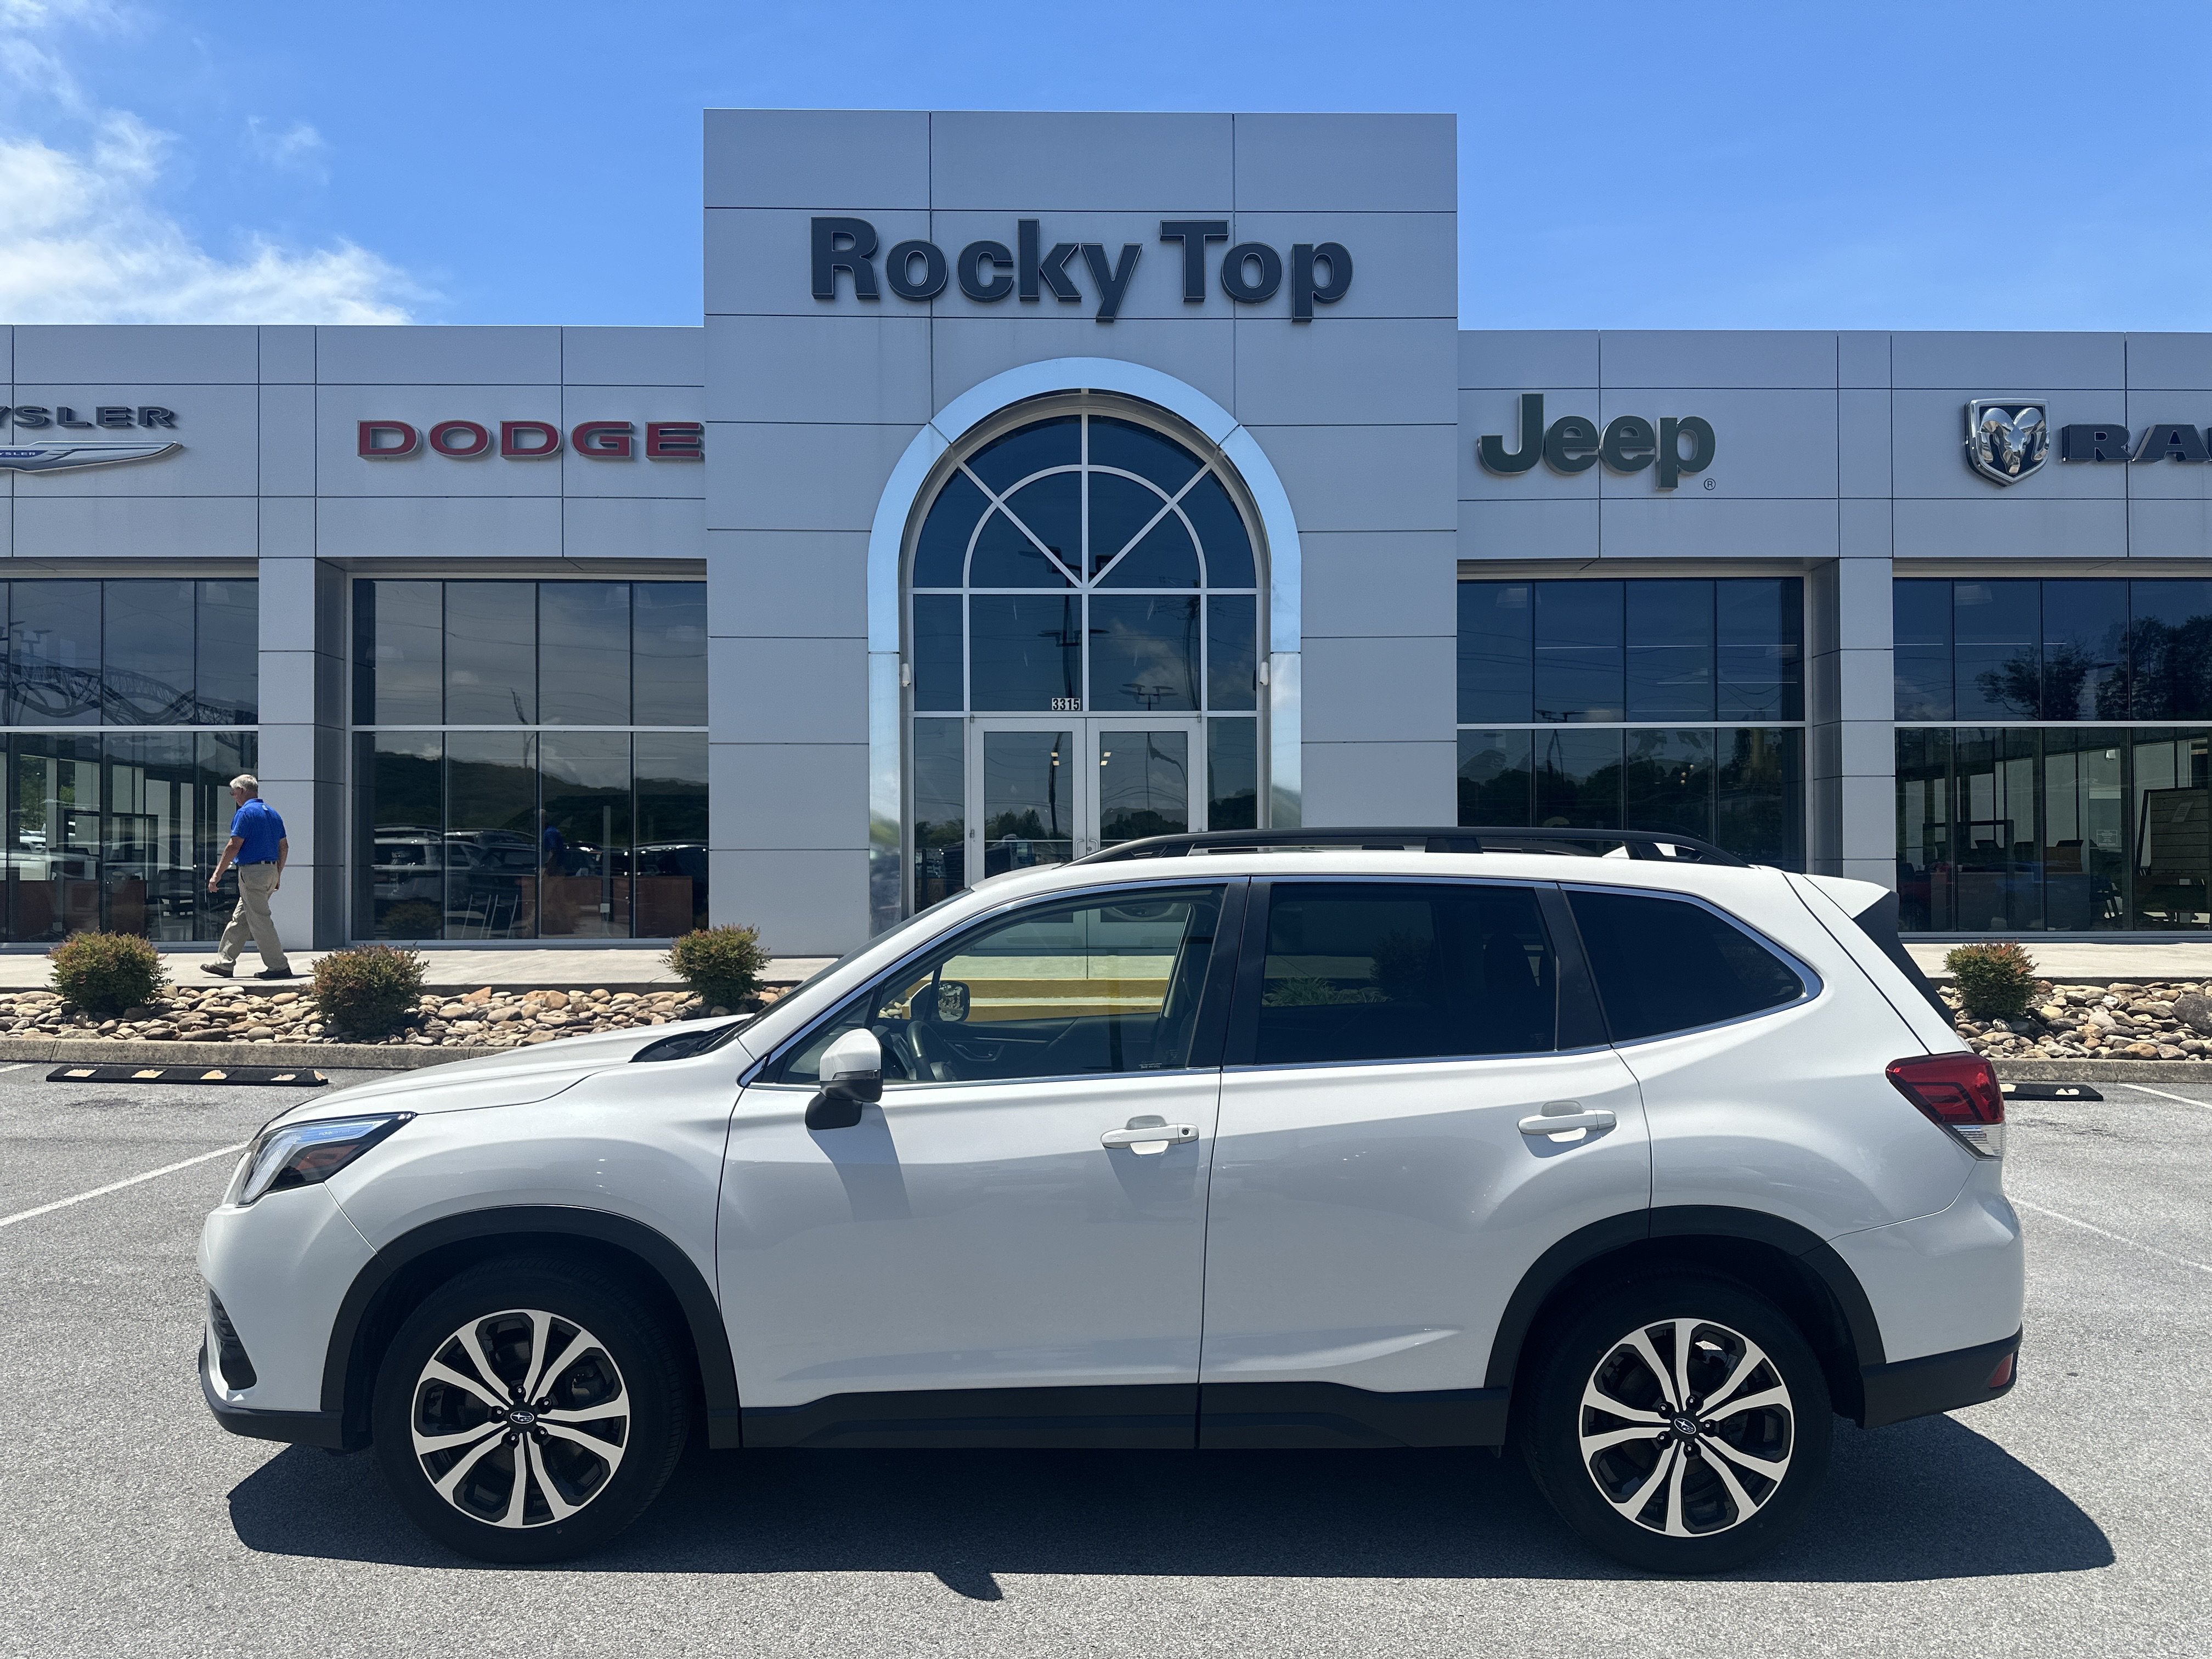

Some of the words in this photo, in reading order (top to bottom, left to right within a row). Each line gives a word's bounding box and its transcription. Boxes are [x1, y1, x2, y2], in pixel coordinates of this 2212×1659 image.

[810, 217, 1143, 323] Rocky
[1159, 219, 1354, 323] Top
[0, 405, 178, 428] SLER
[357, 420, 704, 461] DODGE
[1477, 393, 1716, 491] Jeep
[2062, 424, 2212, 462] RA
[1053, 698, 1080, 710] 3315
